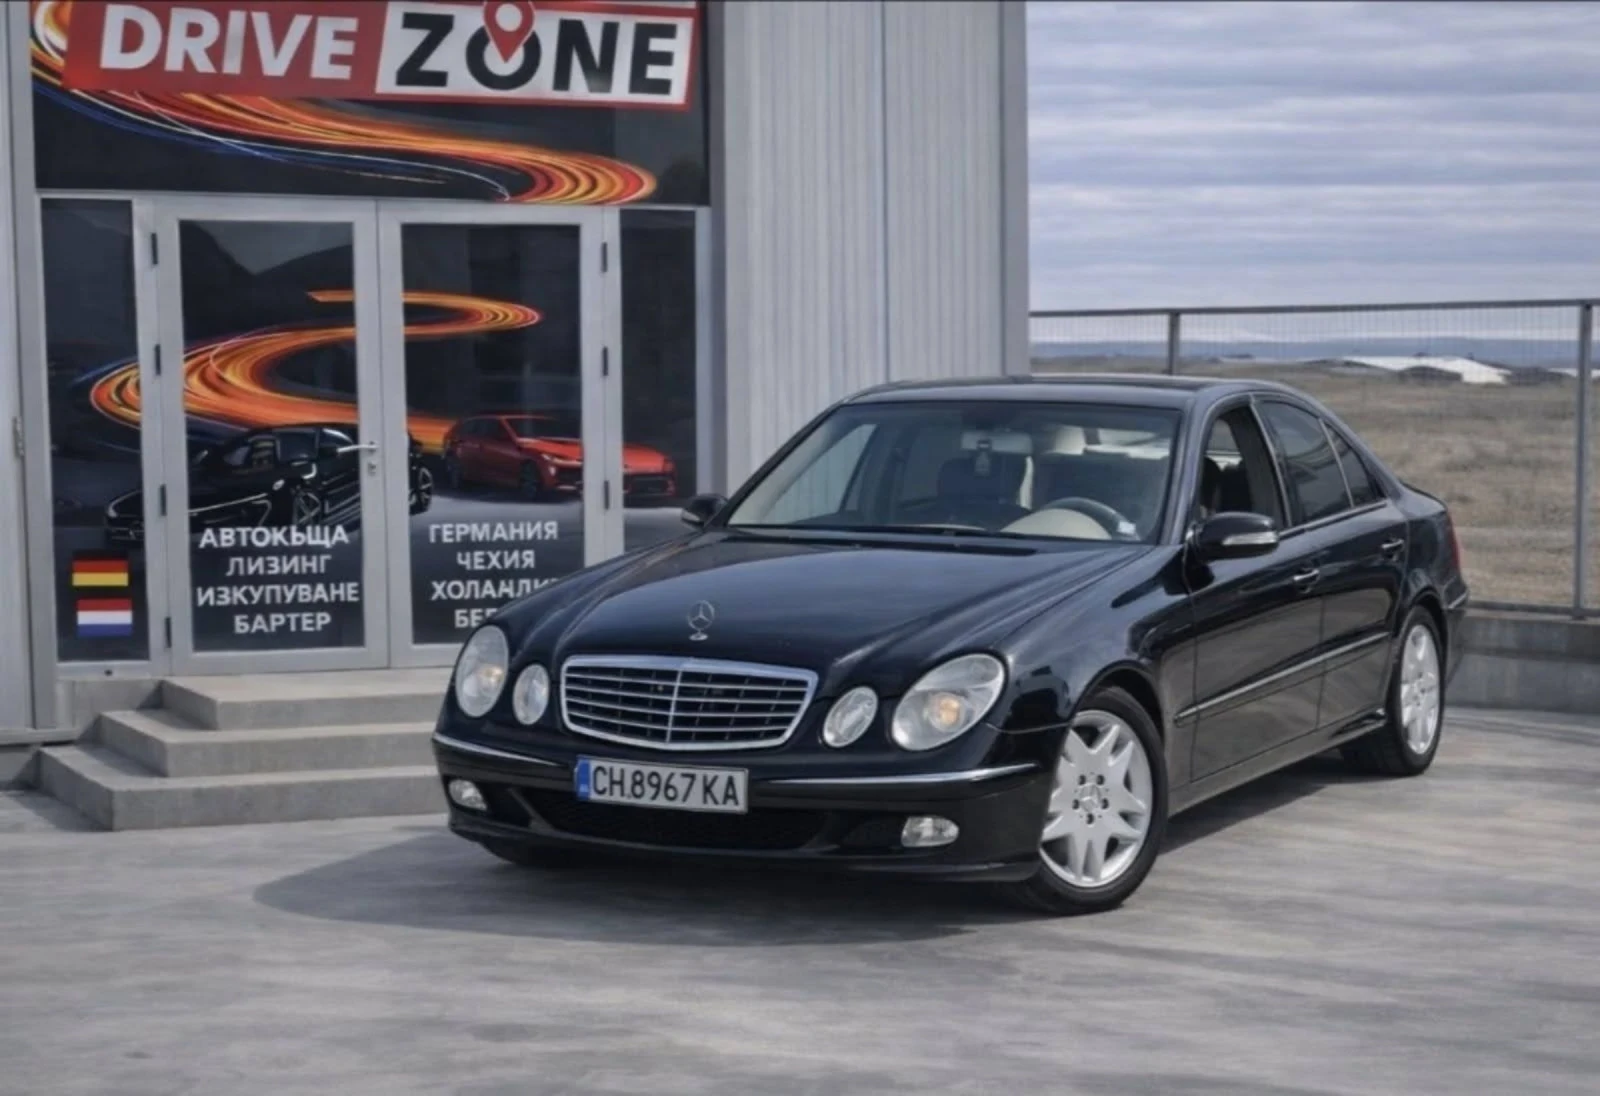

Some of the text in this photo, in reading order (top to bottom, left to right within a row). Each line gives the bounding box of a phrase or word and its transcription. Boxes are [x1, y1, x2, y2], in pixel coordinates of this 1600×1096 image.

[100, 3, 677, 95] DRIVE ZONE
[429, 520, 559, 543] ГЕРМАНИЯ
[225, 554, 332, 577] ЛИЗИНГ
[456, 550, 536, 570] ЧЕХИЯ
[197, 582, 360, 607] ИЗКУПУВАНЕ
[234, 612, 332, 634] БАРТЕР
[630, 769, 696, 803] 8967
[702, 774, 739, 806] KA
